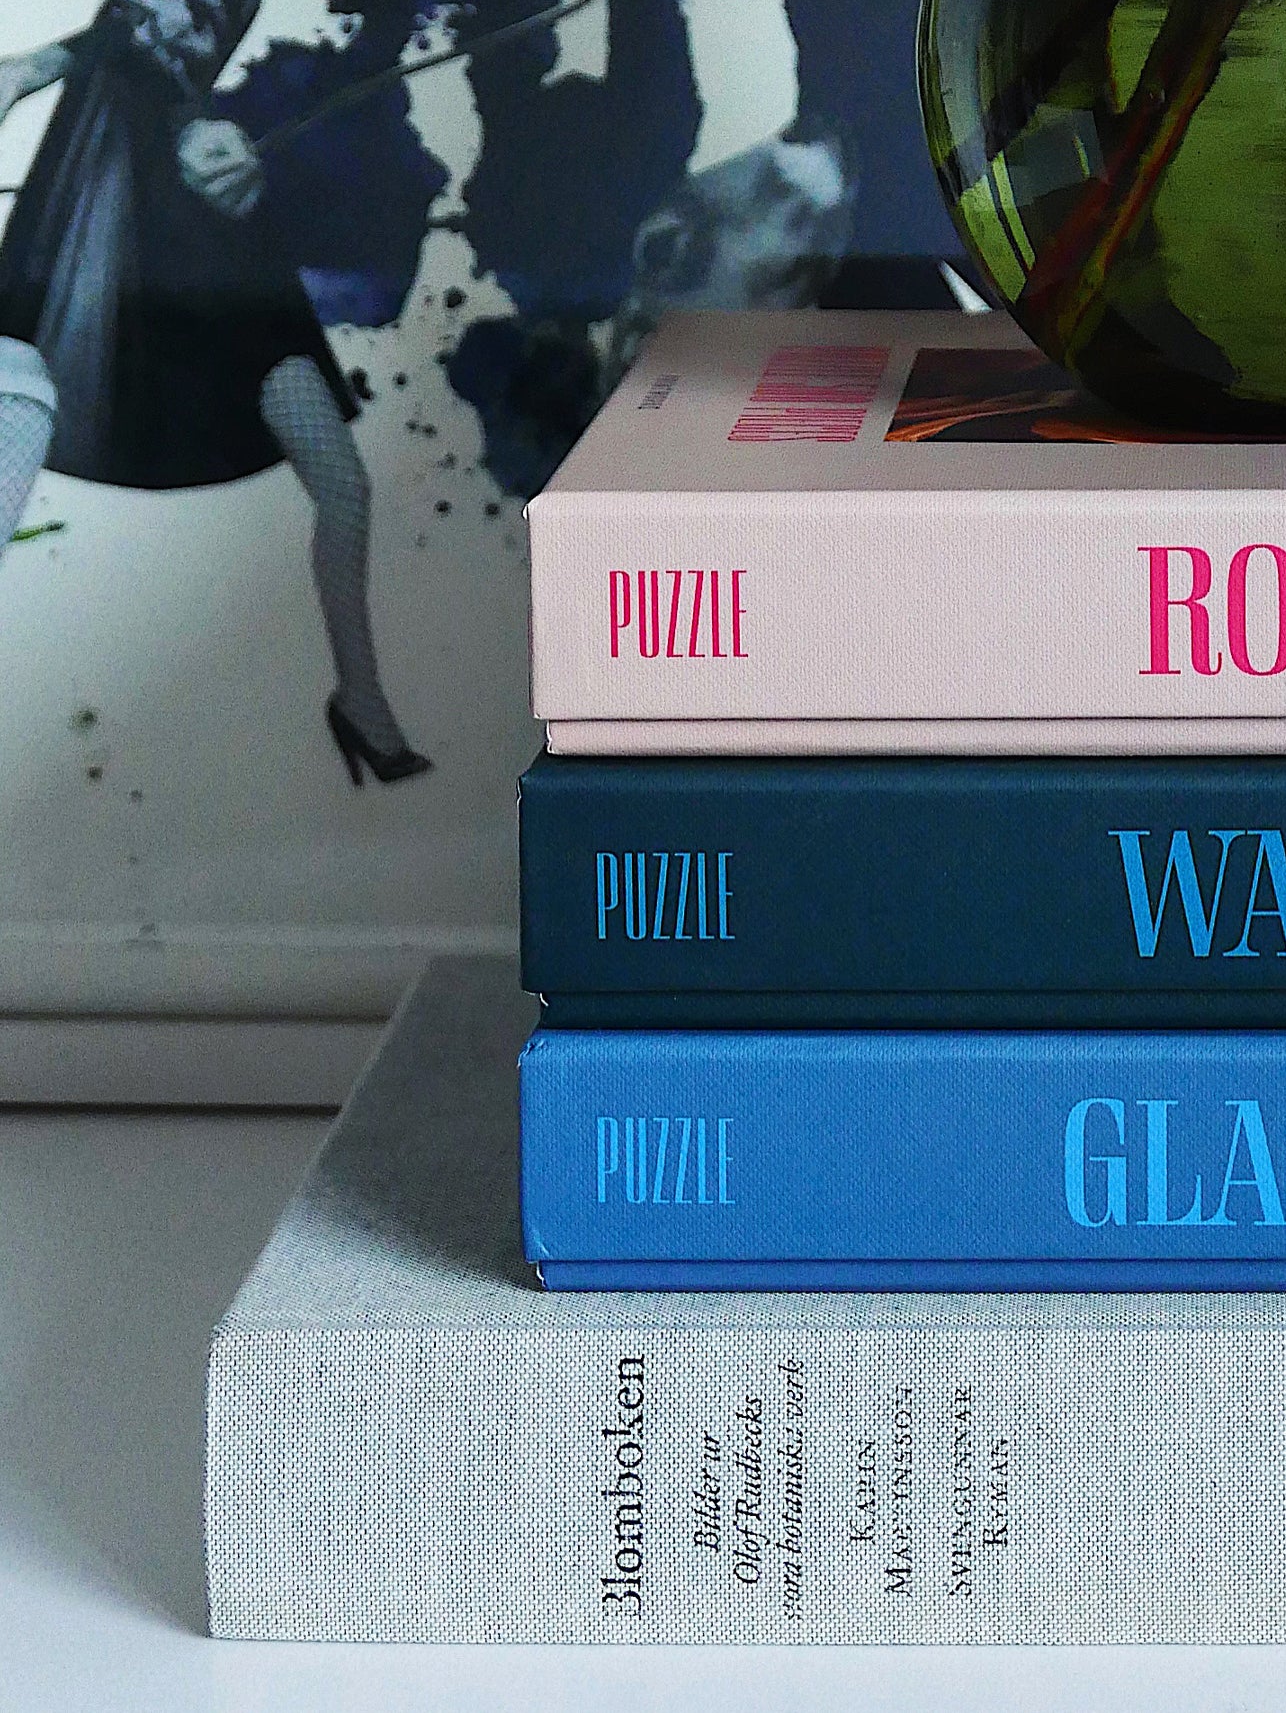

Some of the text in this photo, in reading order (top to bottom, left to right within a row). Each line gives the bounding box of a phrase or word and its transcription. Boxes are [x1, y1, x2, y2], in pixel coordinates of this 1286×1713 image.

[610, 570, 747, 657] PUZZLE
[597, 853, 735, 939] PUZZLE
[597, 1117, 735, 1204] PUZZLE
[778, 1358, 804, 1419] verk
[600, 1354, 645, 1619] Blomboken
[693, 1430, 721, 1552] Bilder ur
[733, 1396, 769, 1584] Olof Rudbecks
